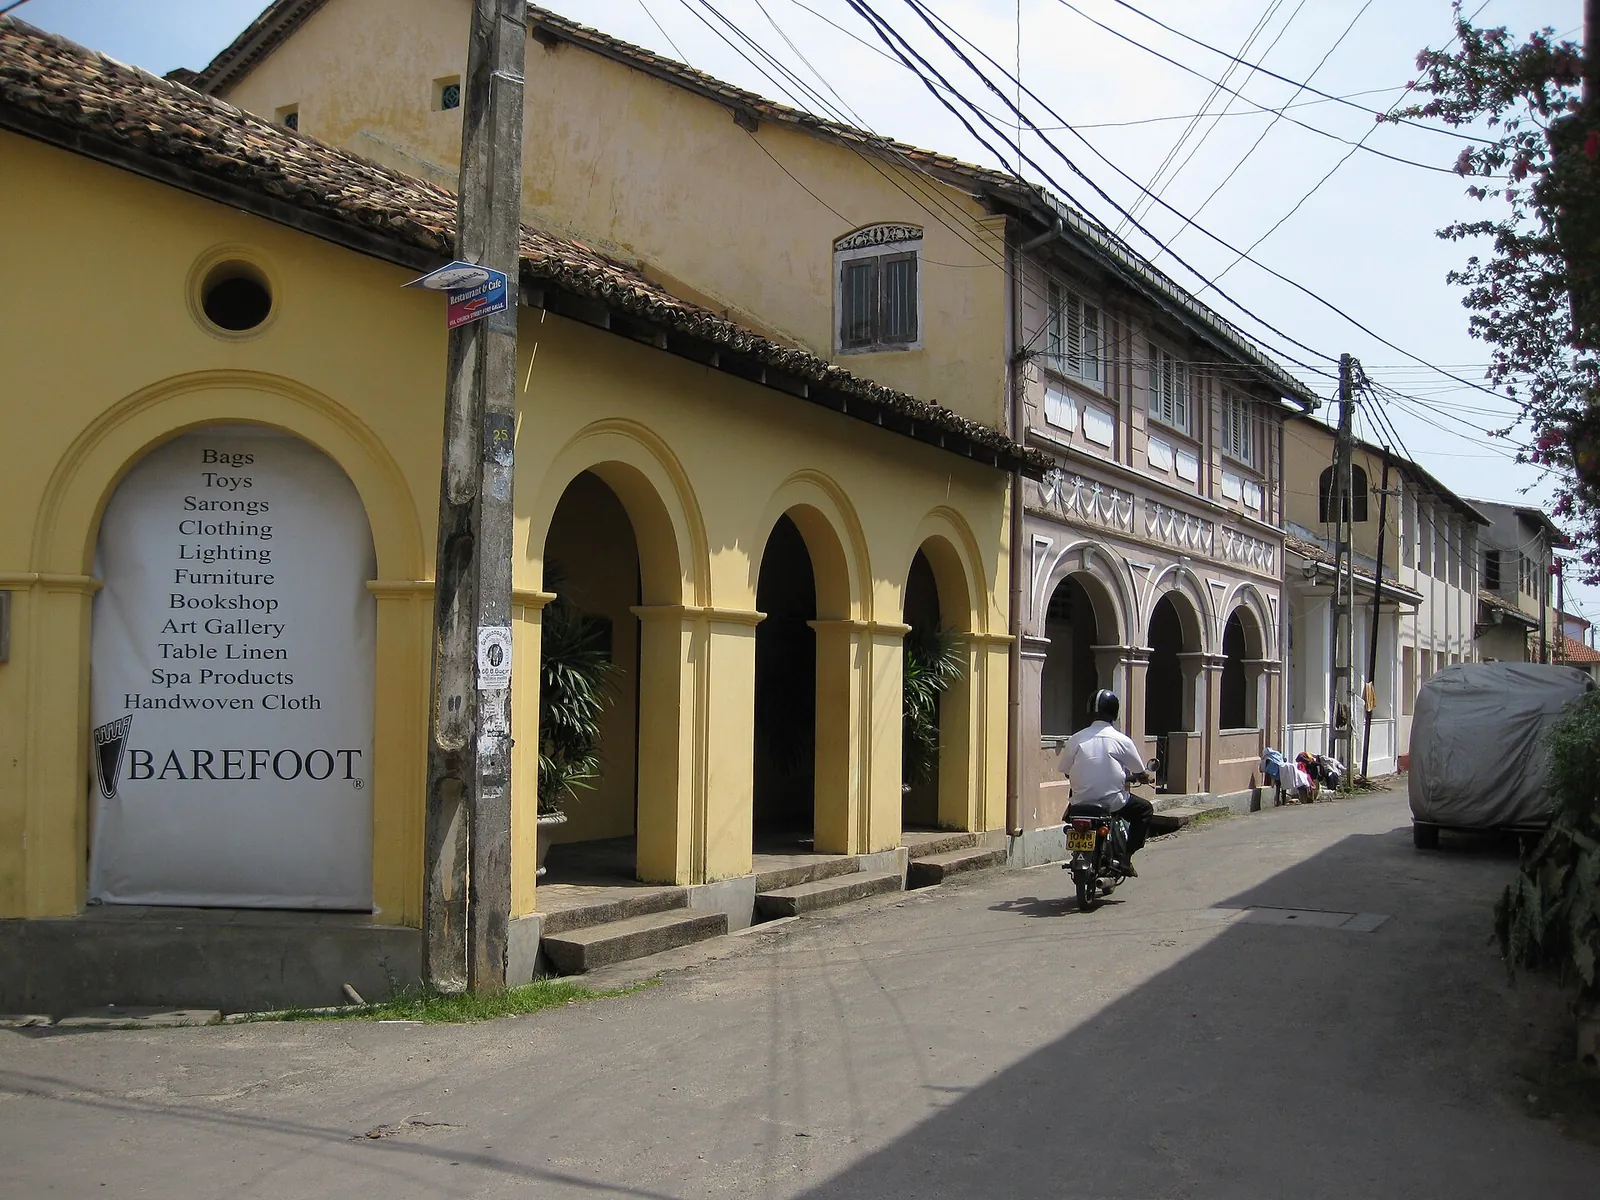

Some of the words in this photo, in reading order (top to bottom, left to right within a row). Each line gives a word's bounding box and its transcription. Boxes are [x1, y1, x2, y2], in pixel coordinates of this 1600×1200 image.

[450, 287, 482, 305] Restaurant
[488, 279, 501, 290] Cafe
[493, 429, 509, 441] 25
[202, 449, 255, 467] Bags
[202, 472, 253, 491] Toys
[183, 495, 270, 515] Sarongs
[178, 520, 273, 539] Clothing
[178, 545, 272, 564] Lighting
[174, 569, 275, 585] Furniture
[169, 593, 279, 614] Bookshop
[161, 618, 198, 634] Art
[204, 618, 285, 639] Gallery
[158, 643, 218, 660] Table
[225, 643, 288, 660] Linen
[151, 668, 193, 689] Spa
[199, 669, 294, 685] Products
[124, 693, 255, 710] Handwoven
[262, 693, 321, 710] Cloth
[127, 749, 363, 780] BAREFOOT
